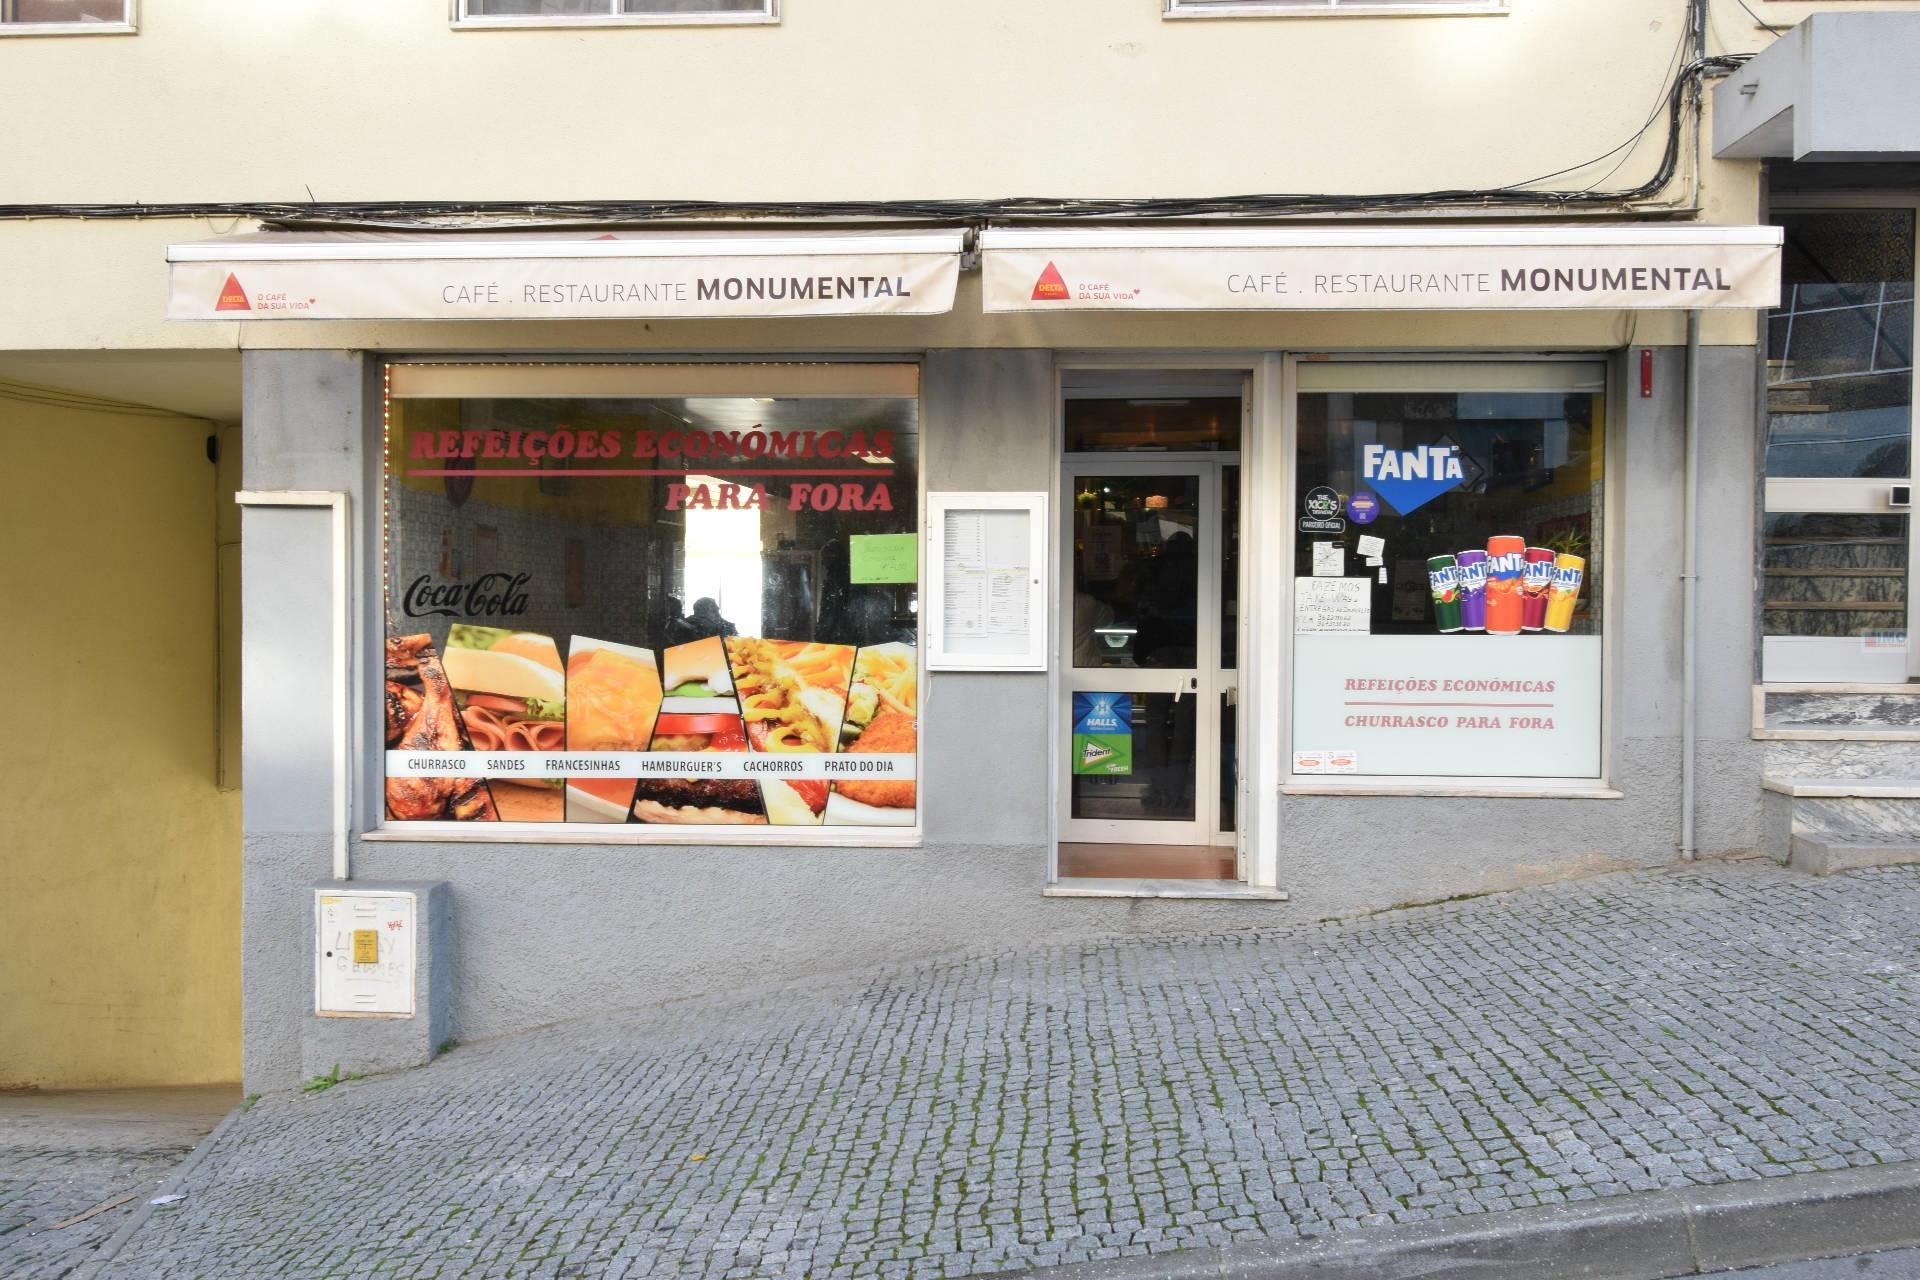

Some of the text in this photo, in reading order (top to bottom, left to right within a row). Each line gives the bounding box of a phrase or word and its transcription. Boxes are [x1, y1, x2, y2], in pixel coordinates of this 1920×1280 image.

[1079, 281, 1109, 291] O CAFÉ
[1227, 271, 1288, 294] CAFÉ
[1314, 272, 1491, 294] RESTAURANTE
[1501, 266, 1732, 292] MONUMENTAL
[257, 293, 264, 301] O
[442, 281, 500, 304] CAFÉ
[523, 282, 688, 304] RESTAURANTE
[696, 275, 911, 301] MONUMENTAL
[1079, 292, 1134, 301] DA SUA VIDA
[257, 302, 309, 310] DA SUA VIDA
[408, 424, 895, 466] REFEIÇÕES ECONÓMICAS
[1363, 444, 1464, 481] FANTA
[665, 482, 893, 511] PARA FORA
[1344, 677, 1556, 695] REFEIÇÕES ECONÓMICAS
[1087, 718, 1117, 726] HALLS
[1344, 715, 1555, 730] CHURRASCO PARA FORA
[1083, 747, 1111, 758] Trident
[407, 757, 894, 773] CHURRASCO SANDES FRANCESINHAS HAMBURGUER'S CACHORROS PRATO DO DIA
